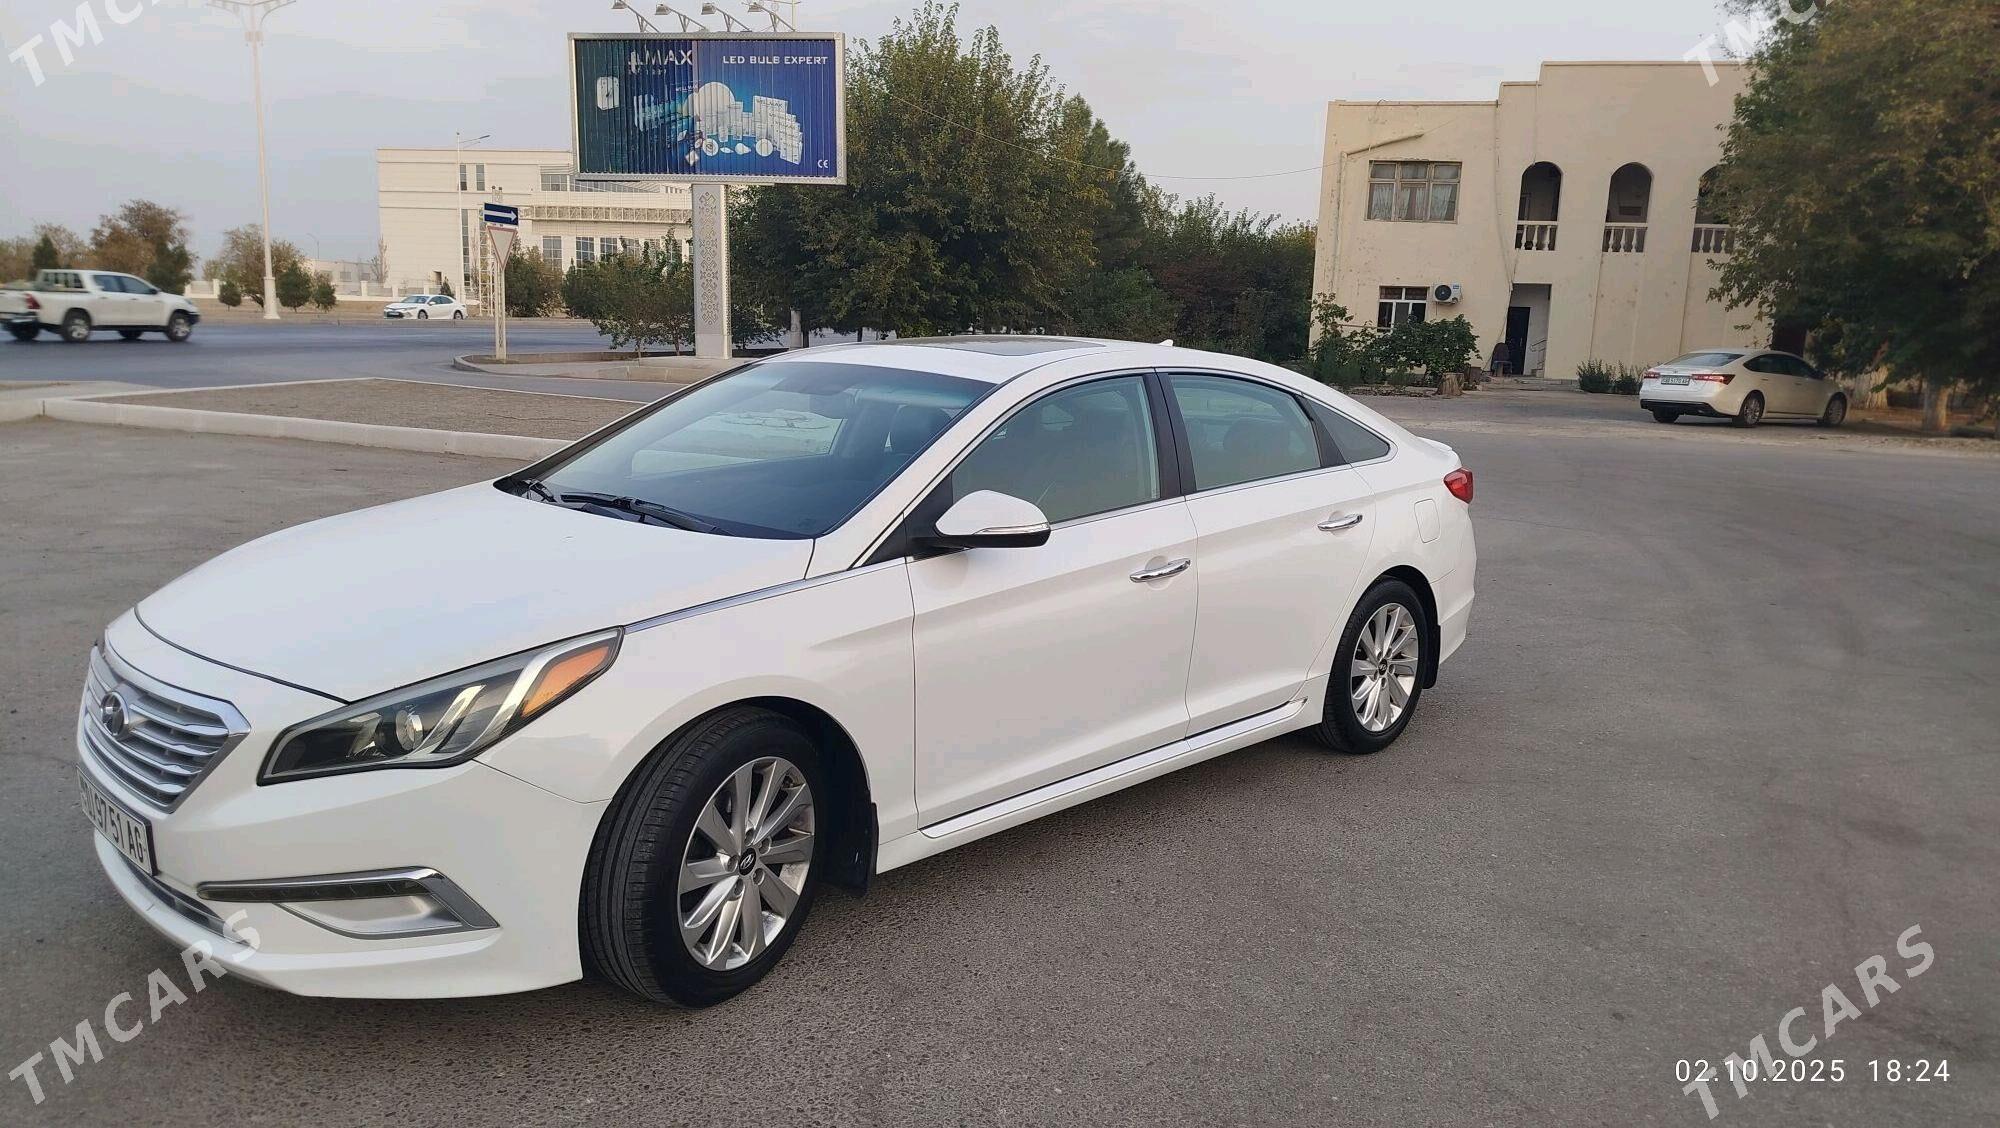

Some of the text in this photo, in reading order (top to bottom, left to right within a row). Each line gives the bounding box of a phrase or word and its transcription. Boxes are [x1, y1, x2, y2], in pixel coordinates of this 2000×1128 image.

[722, 55, 829, 65] LED BULB EXPERT
[817, 159, 829, 169] CE
[127, 819, 144, 863] AG
